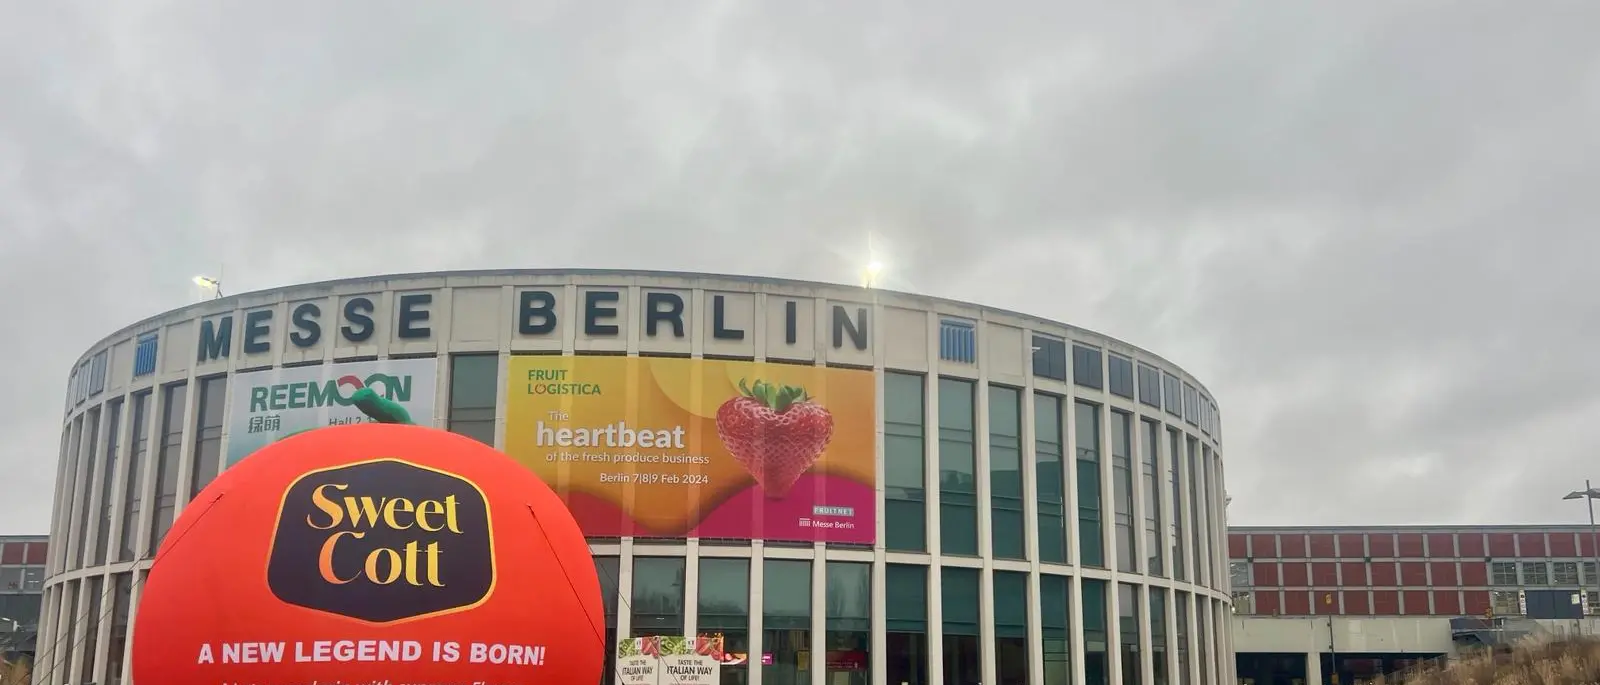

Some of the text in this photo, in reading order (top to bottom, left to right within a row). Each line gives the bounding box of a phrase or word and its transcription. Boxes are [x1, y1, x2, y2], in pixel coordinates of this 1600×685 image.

[199, 290, 868, 361] MESSE BERLIN
[528, 369, 568, 380] FRUIT
[250, 373, 412, 413] REEMOON
[527, 383, 601, 395] LOGISTICA
[548, 410, 569, 421] The
[536, 420, 686, 449] heartbeat
[546, 452, 710, 465] of the fresh produce business
[600, 473, 630, 483] Berlin
[661, 475, 680, 484] Feb
[683, 475, 708, 484] 2024
[307, 484, 464, 534] Sweet
[318, 532, 446, 587] Cott
[198, 640, 546, 666] A NEW LEGEND IS BORN!
[666, 666, 712, 675] ITALIAN WAY
